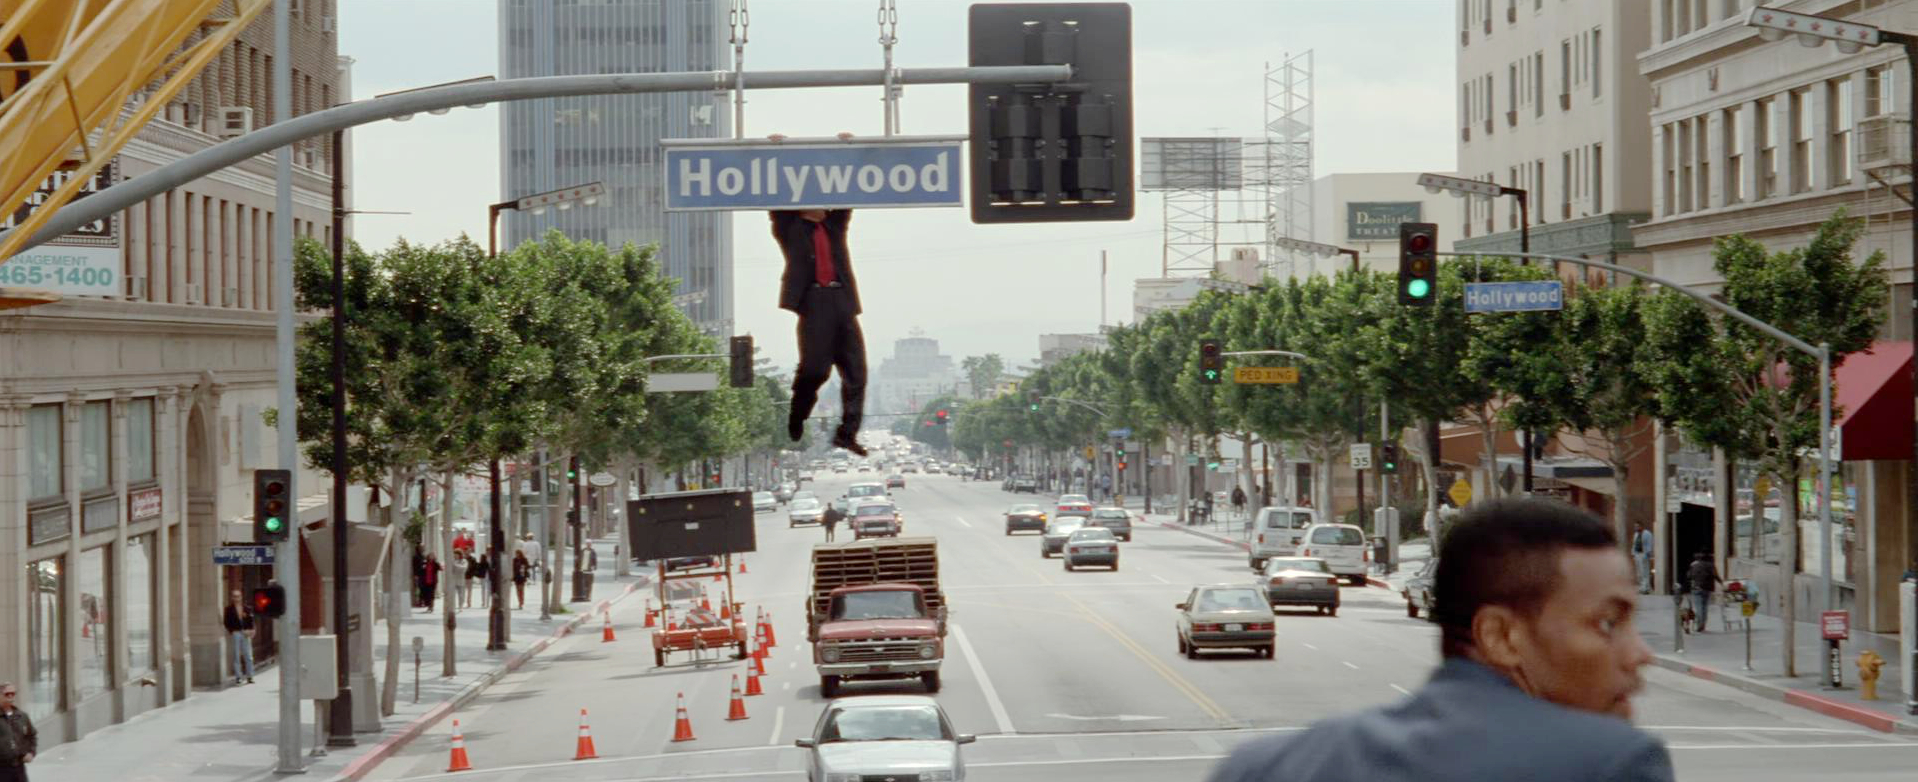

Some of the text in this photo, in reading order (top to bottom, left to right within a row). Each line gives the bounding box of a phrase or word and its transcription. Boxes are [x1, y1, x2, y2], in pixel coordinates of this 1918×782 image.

[679, 151, 949, 202] Hollywood
[1356, 227, 1397, 235] THEAT
[10, 255, 88, 266] NAGEMENT
[1467, 287, 1558, 308] Hollywood
[1240, 370, 1293, 380] PED XING
[1354, 457, 1368, 466] 35
[214, 548, 256, 559] Hollywood
